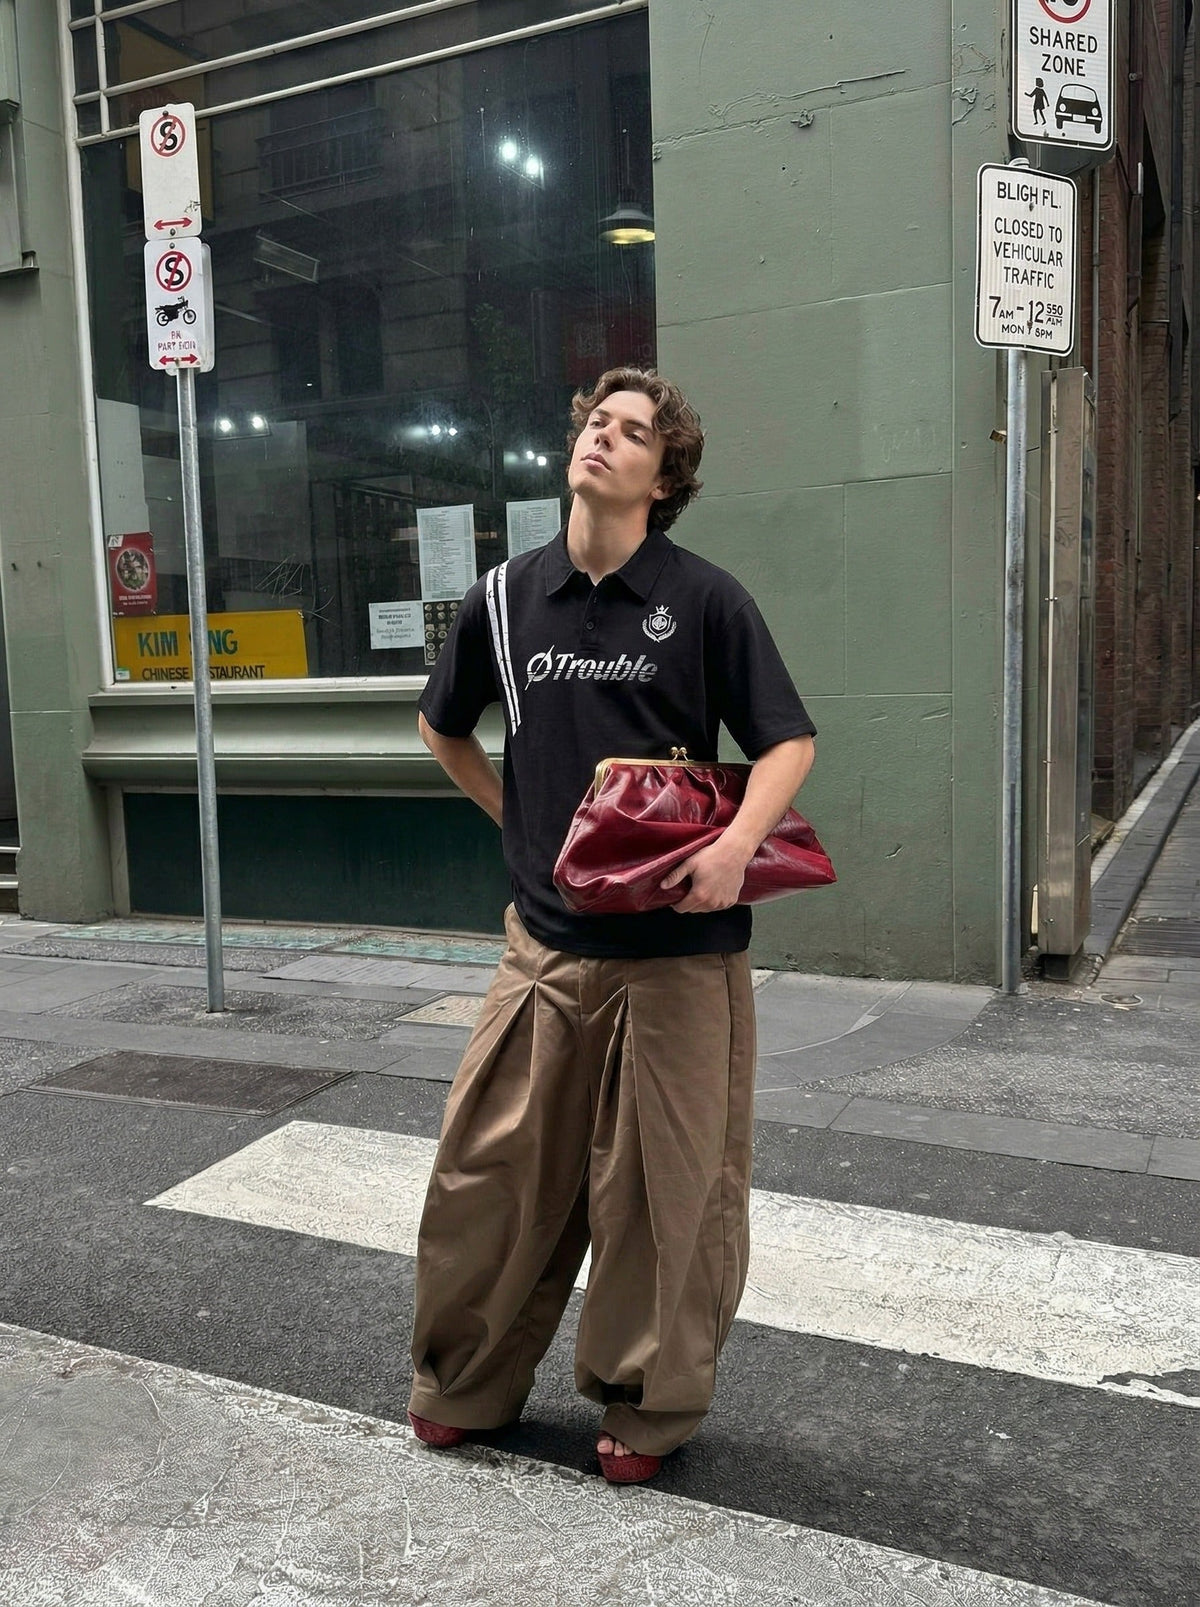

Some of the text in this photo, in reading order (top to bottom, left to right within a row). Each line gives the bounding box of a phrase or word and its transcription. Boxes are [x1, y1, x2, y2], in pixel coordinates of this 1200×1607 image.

[1029, 26, 1098, 53] SHARED
[1041, 53, 1086, 77] ZONE
[997, 181, 1038, 205] BLIGH
[994, 217, 1063, 243] CLOSED TO
[993, 241, 1063, 267] VEHICULAR
[1003, 266, 1054, 289] TRAFFIC
[1001, 324, 1025, 335] MON
[138, 630, 179, 657] KIM
[142, 664, 266, 681] CHINESE STAURANT
